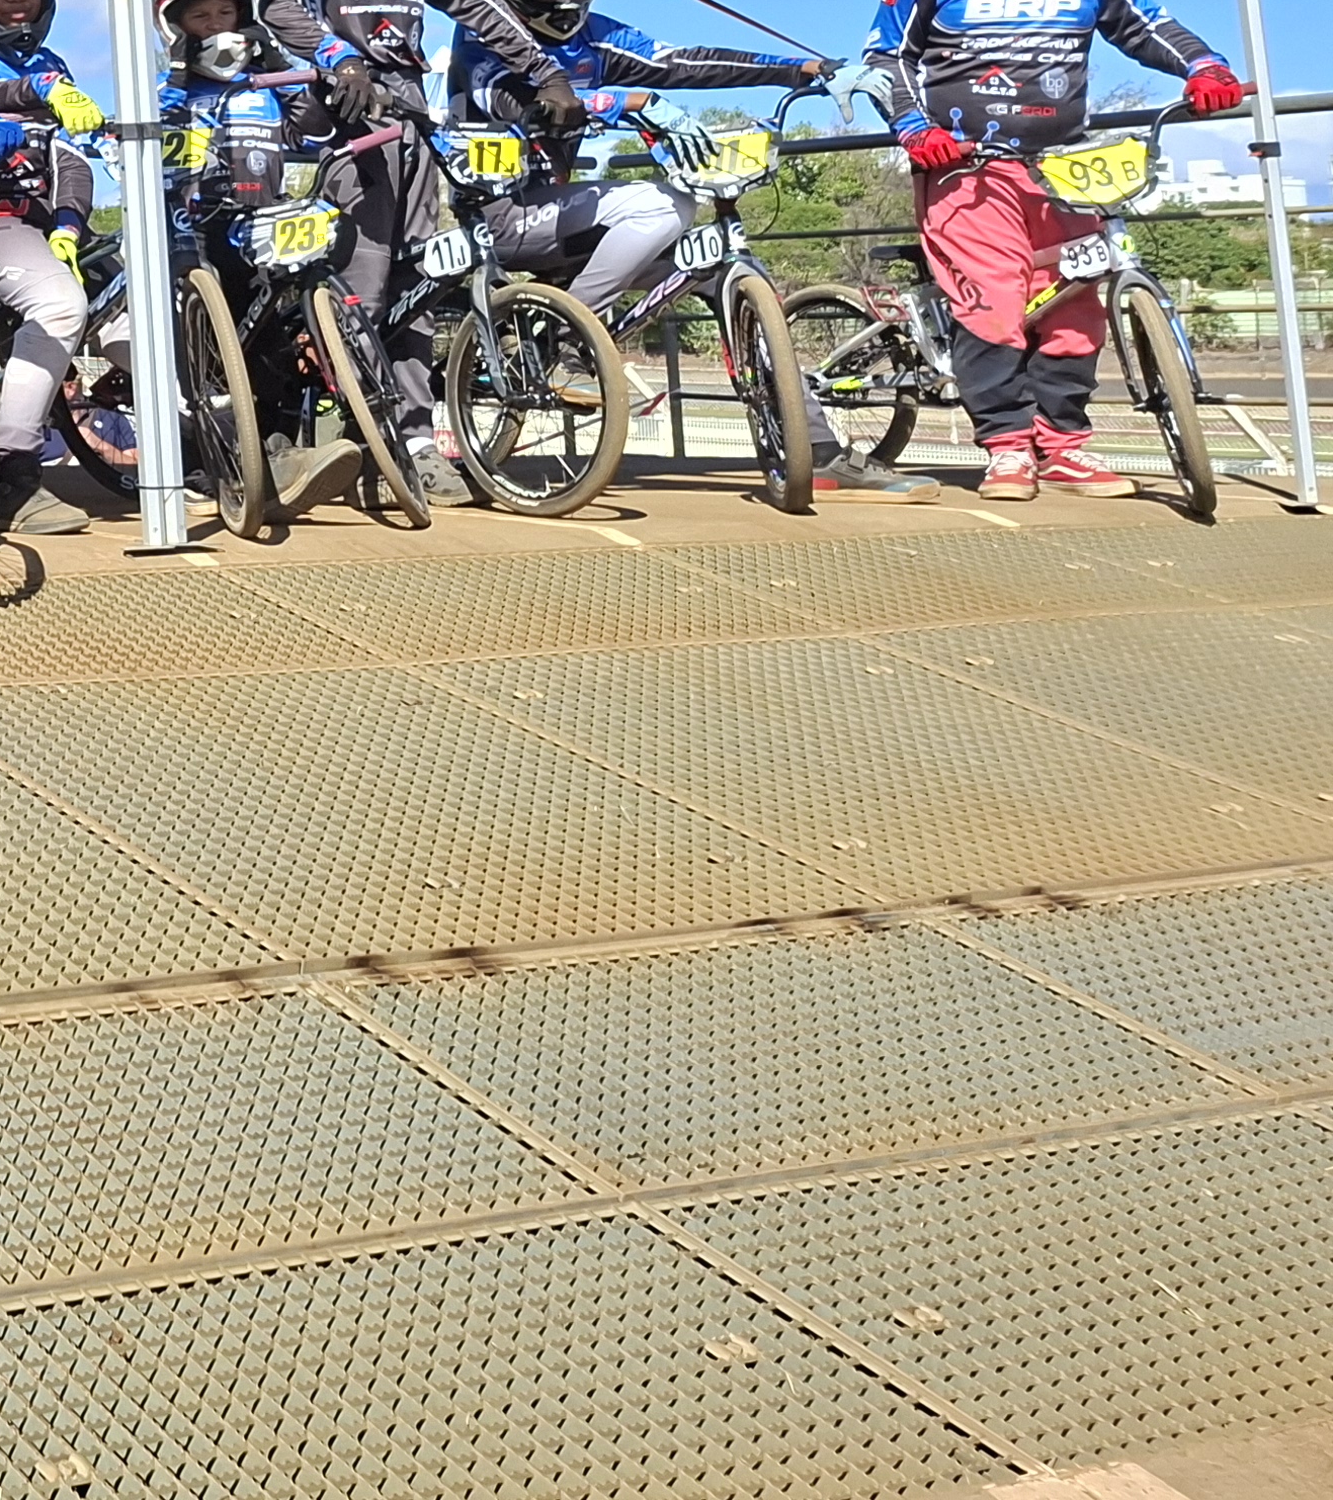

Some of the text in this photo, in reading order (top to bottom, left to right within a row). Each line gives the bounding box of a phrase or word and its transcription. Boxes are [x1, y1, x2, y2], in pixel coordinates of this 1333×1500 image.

[1069, 157, 1140, 192] 93 B
[1068, 243, 1108, 270] 93 B
